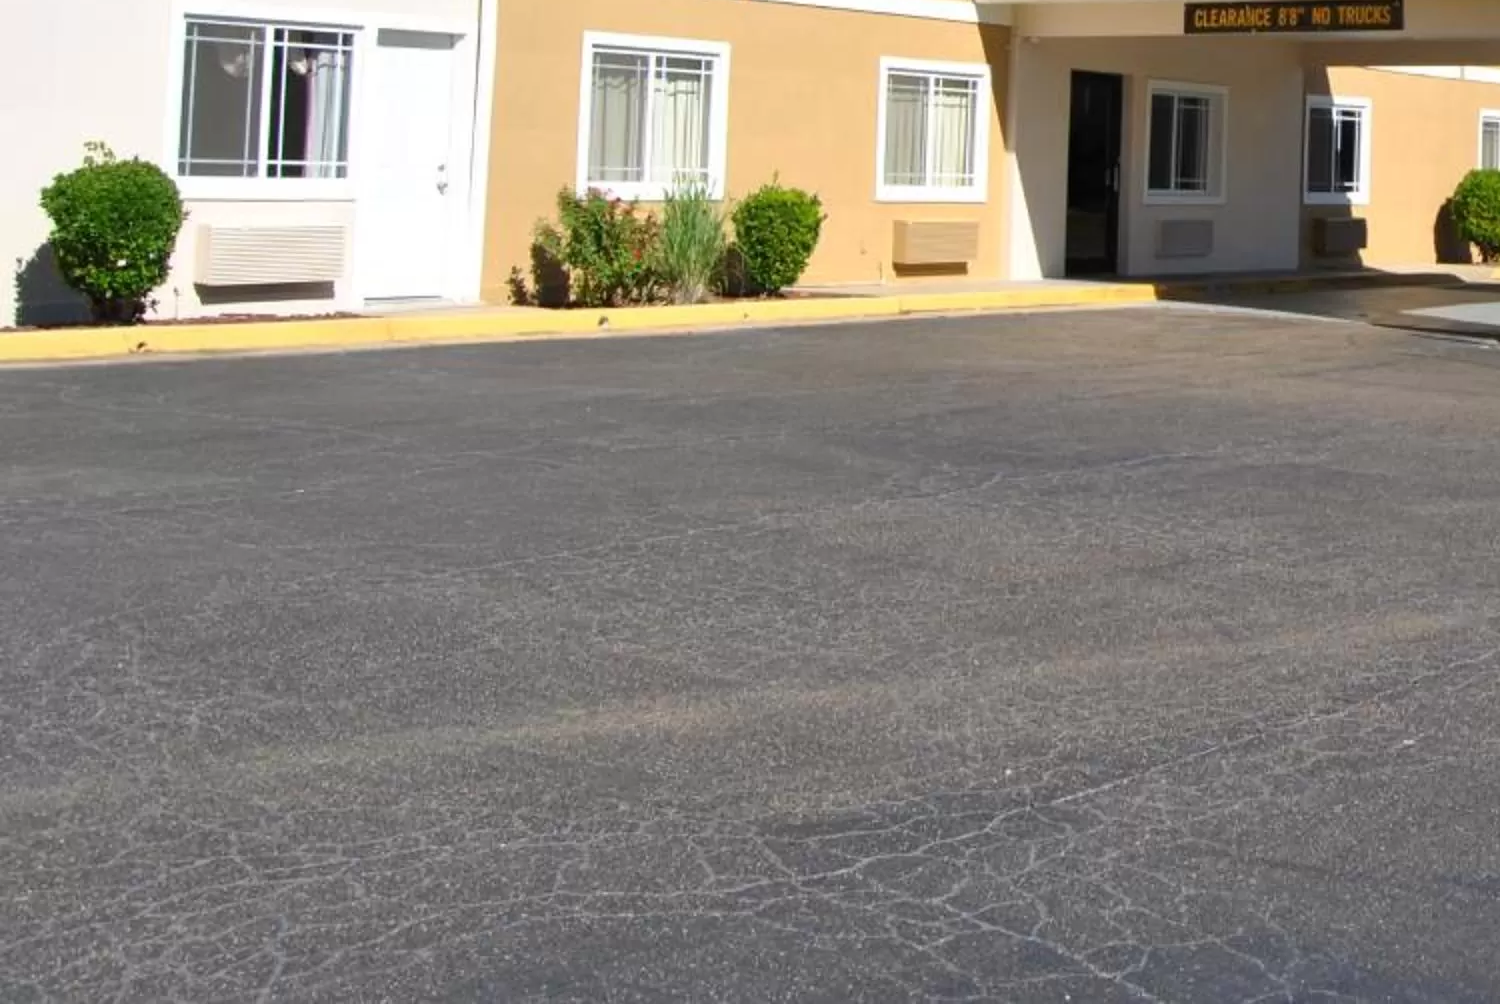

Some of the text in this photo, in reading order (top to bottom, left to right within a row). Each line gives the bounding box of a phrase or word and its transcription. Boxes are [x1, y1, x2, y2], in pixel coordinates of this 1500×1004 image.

[1195, 6, 1271, 28] CLEARANCE
[1311, 6, 1331, 25] NO
[1337, 4, 1392, 25] TRUCKS
